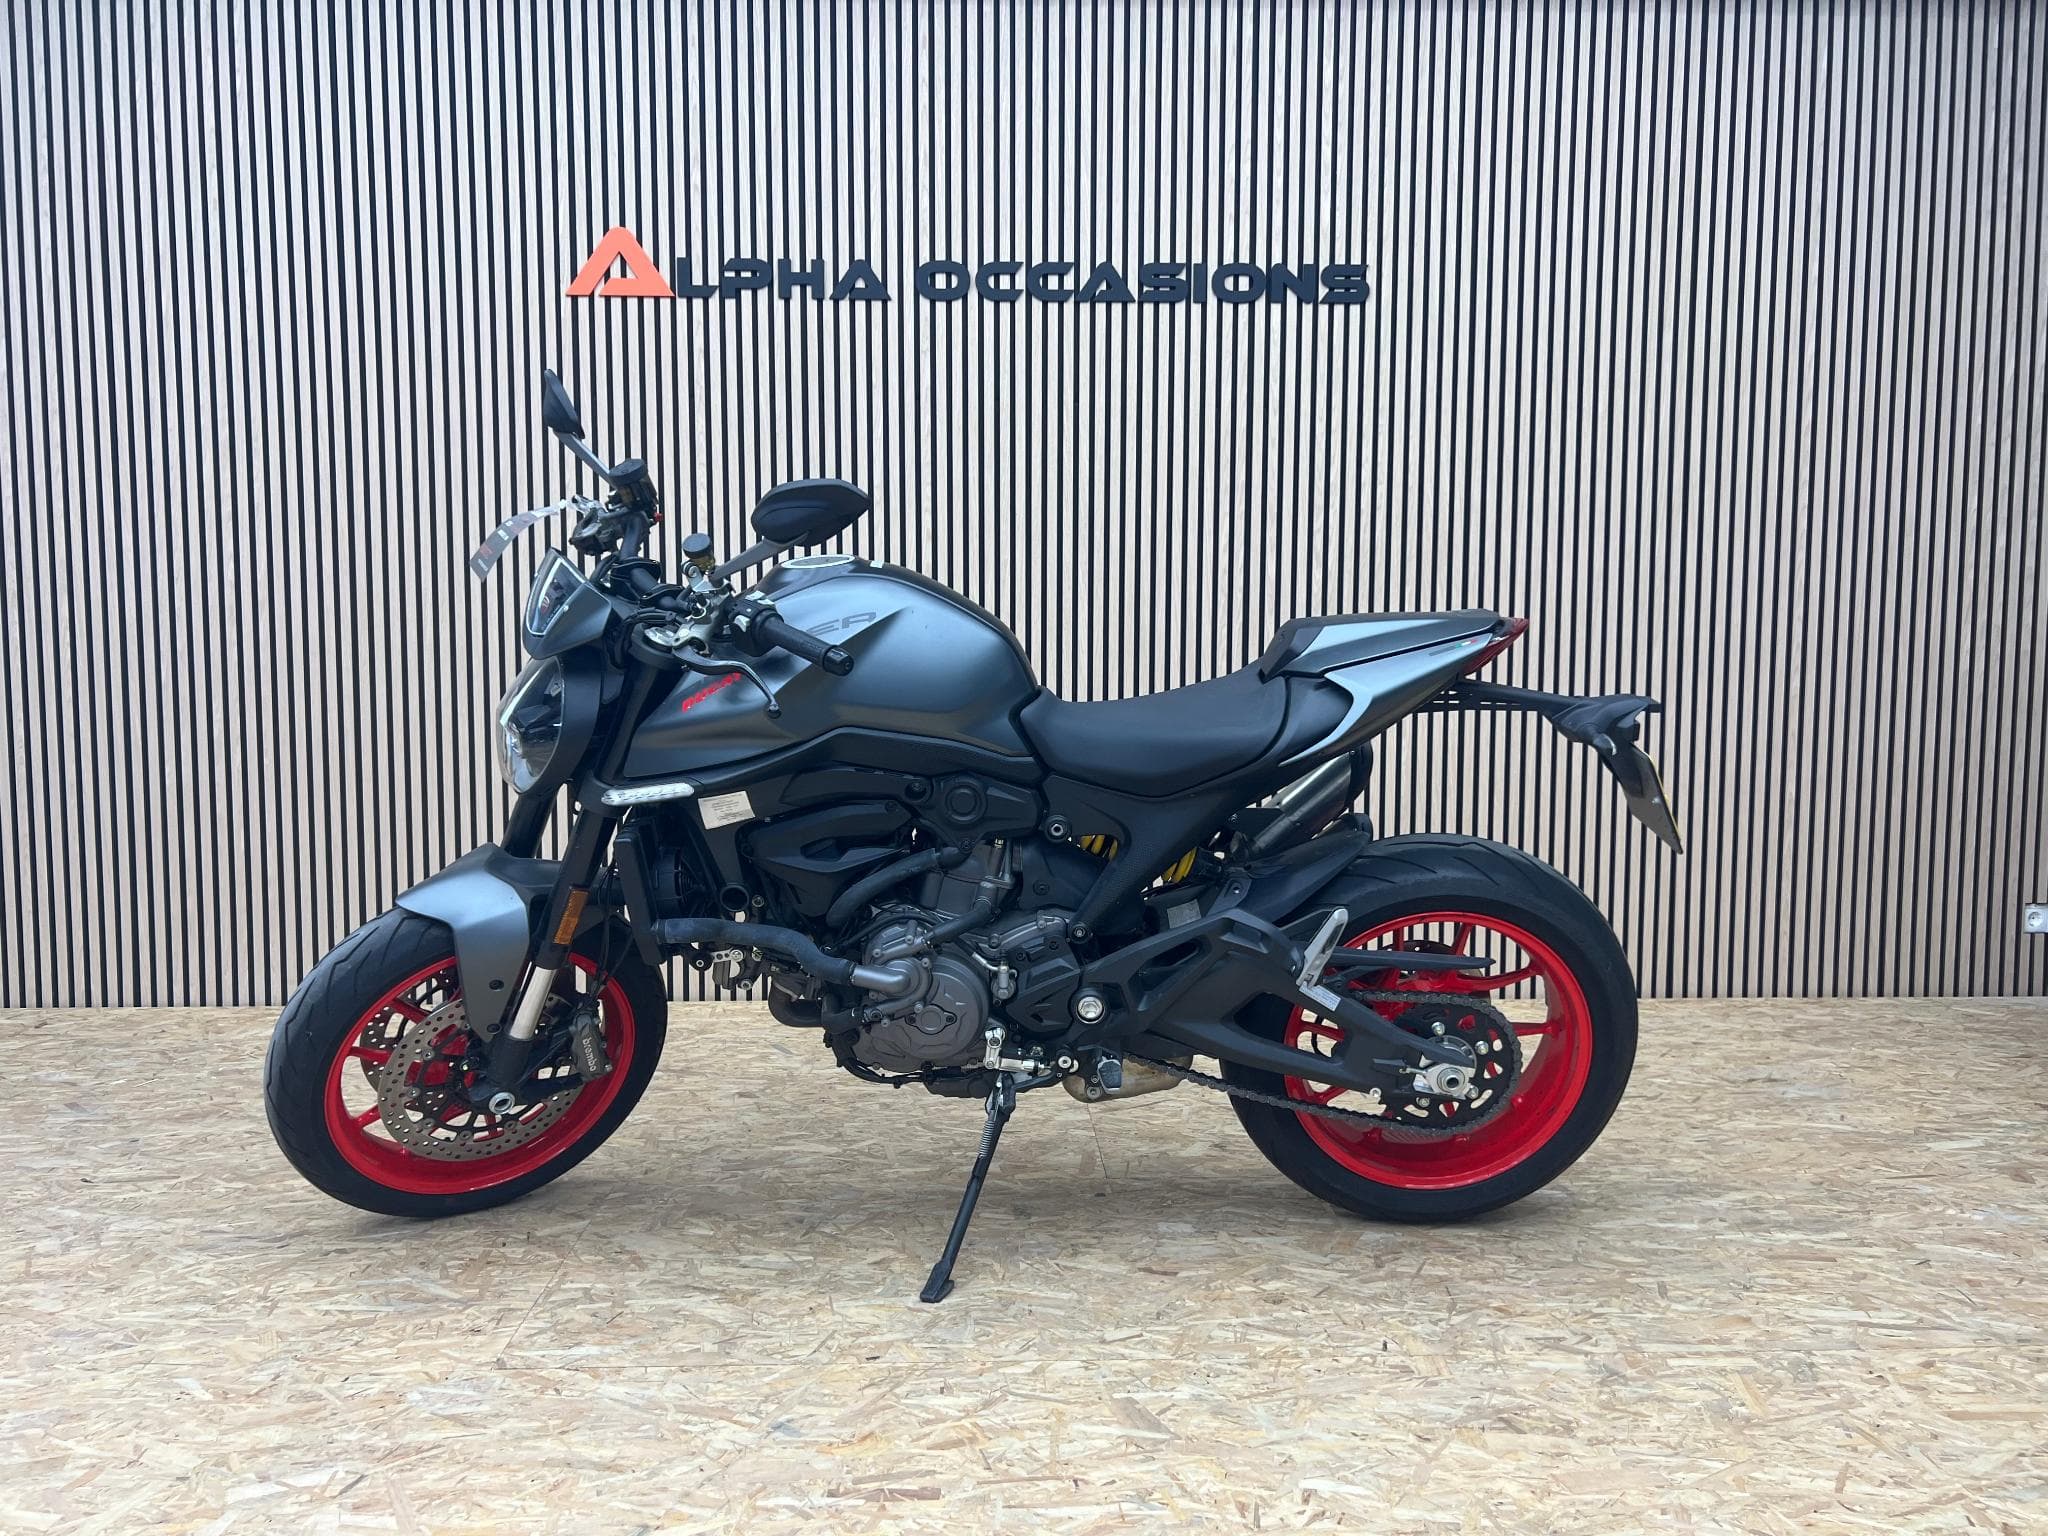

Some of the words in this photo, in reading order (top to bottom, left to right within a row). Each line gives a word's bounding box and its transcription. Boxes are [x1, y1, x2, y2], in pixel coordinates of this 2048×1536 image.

[566, 226, 891, 300] ALPHA
[916, 260, 1370, 304] OCCASIONS
[681, 672, 743, 714] DUCAT
[582, 1037, 598, 1072] brembo
